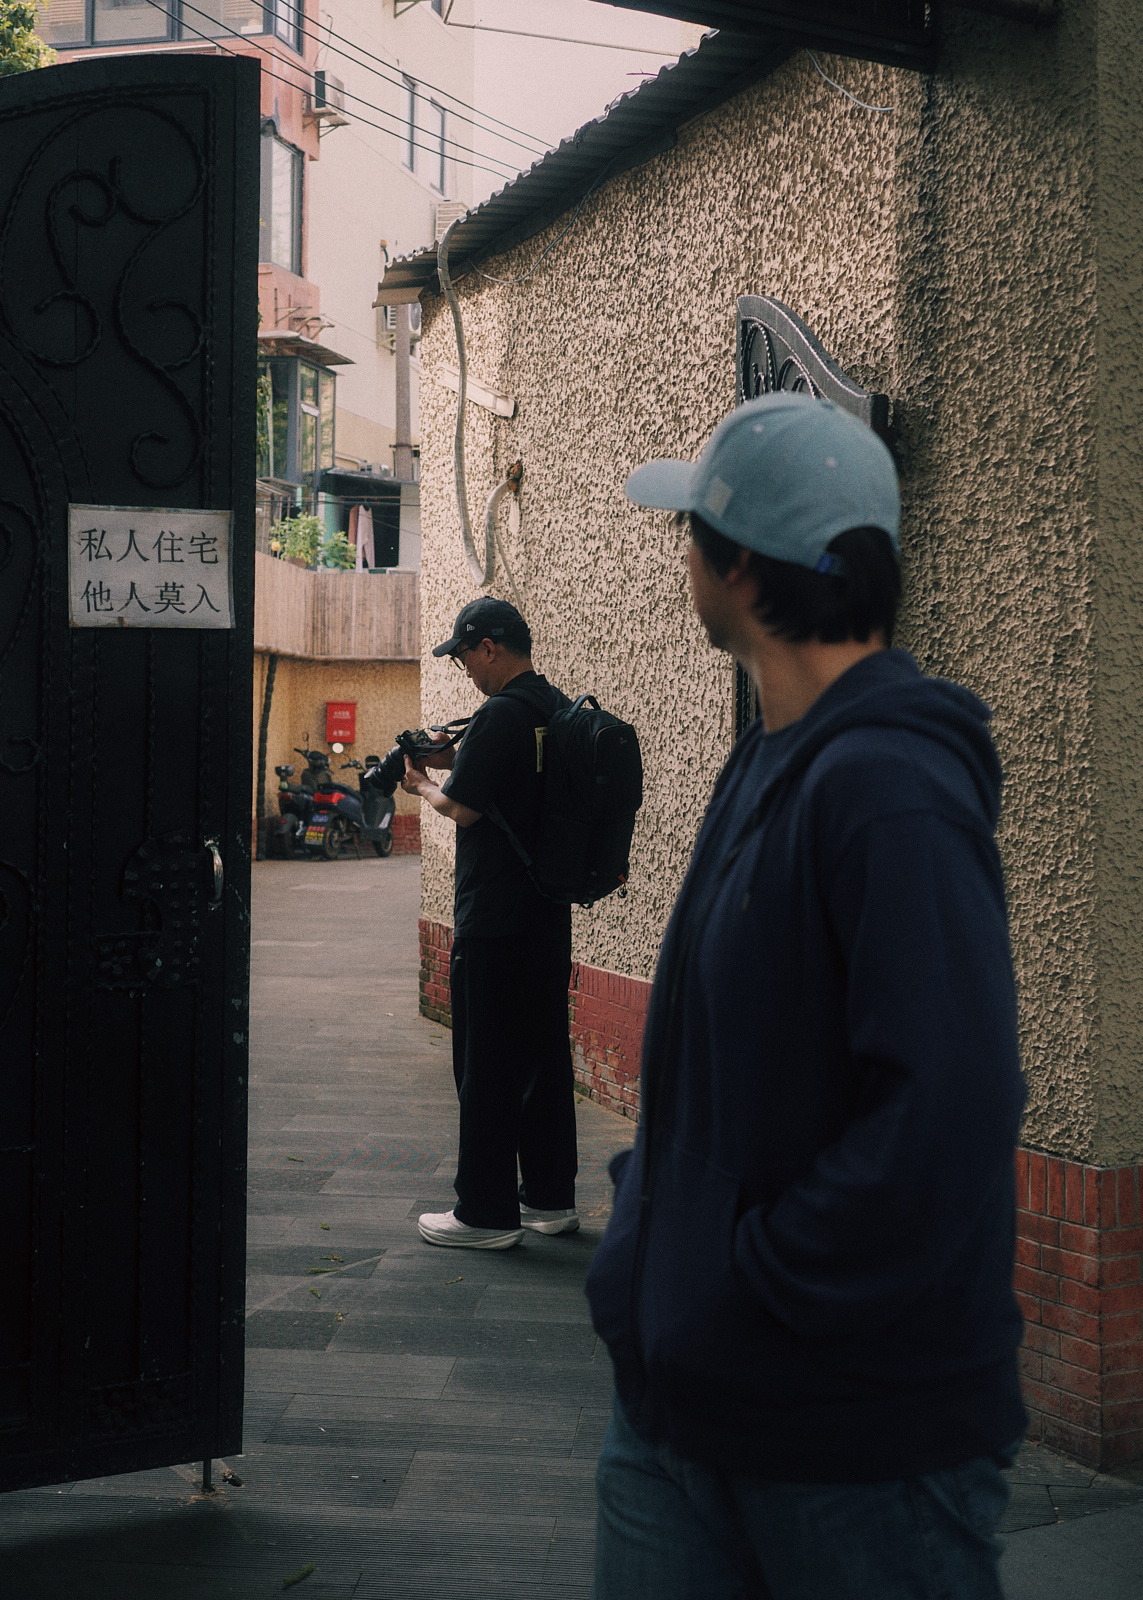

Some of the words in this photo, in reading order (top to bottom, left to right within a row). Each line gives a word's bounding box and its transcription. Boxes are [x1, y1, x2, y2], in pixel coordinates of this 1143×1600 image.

[80, 528, 219, 564] 私人住宅
[80, 580, 221, 614] 他人莫入
